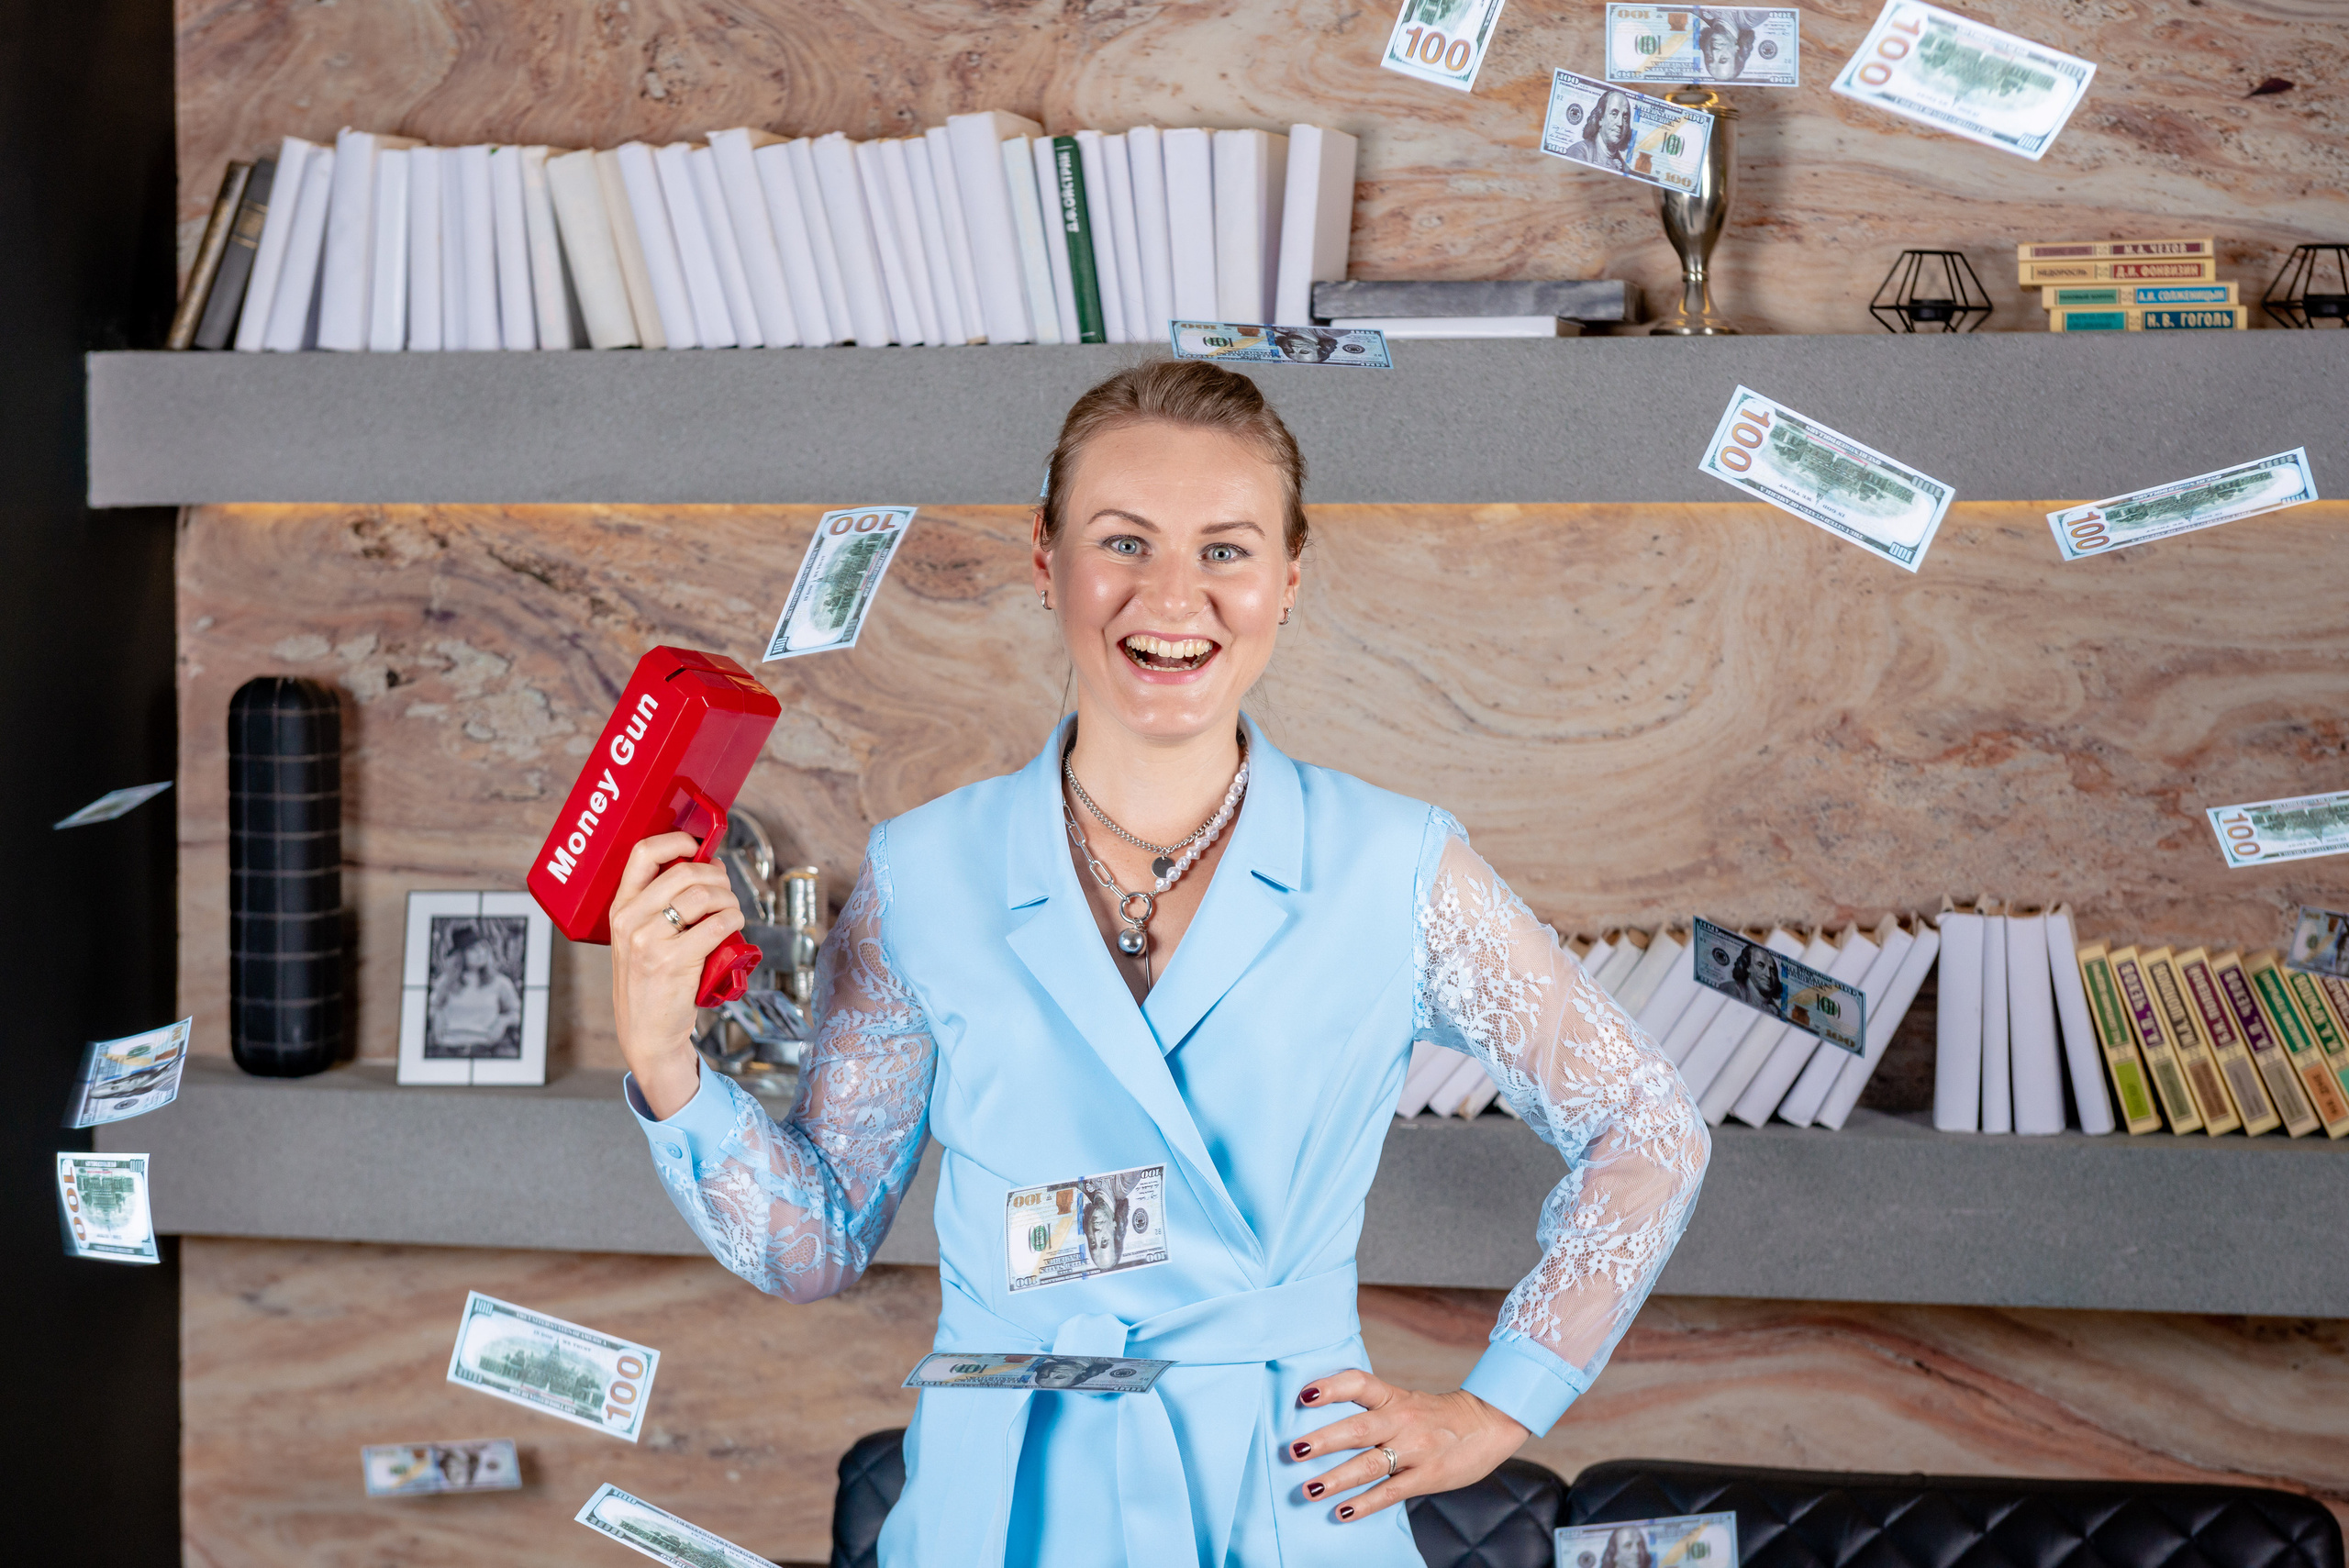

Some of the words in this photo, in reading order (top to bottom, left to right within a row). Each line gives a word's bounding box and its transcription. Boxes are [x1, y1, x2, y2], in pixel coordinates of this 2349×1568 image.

[1617, 8, 1650, 18] 100
[1406, 27, 1471, 72] 100
[1859, 18, 1920, 85] 100
[1558, 72, 1579, 85] 100
[1683, 111, 1704, 124] 100
[1664, 171, 1691, 187] 100
[2180, 312, 2232, 328] ГОГОЛЬ
[1201, 336, 1234, 348] 100
[1720, 409, 1771, 473] 100
[829, 514, 895, 535] 100
[2067, 511, 2110, 550] 100
[547, 768, 620, 884] Money
[609, 693, 659, 766] Gun
[2222, 812, 2261, 856] 100
[2119, 962, 2149, 1012] ЧЕХОВ
[2152, 962, 2187, 1021] ШОЛОХОВ
[2222, 969, 2255, 1018] ЧЕХОВ
[1140, 1167, 1160, 1179] 100
[63, 1166, 86, 1240] 100
[1012, 1191, 1042, 1208] 100
[1015, 1274, 1037, 1288] 100
[474, 1299, 494, 1316] 100
[607, 1356, 644, 1420] 100
